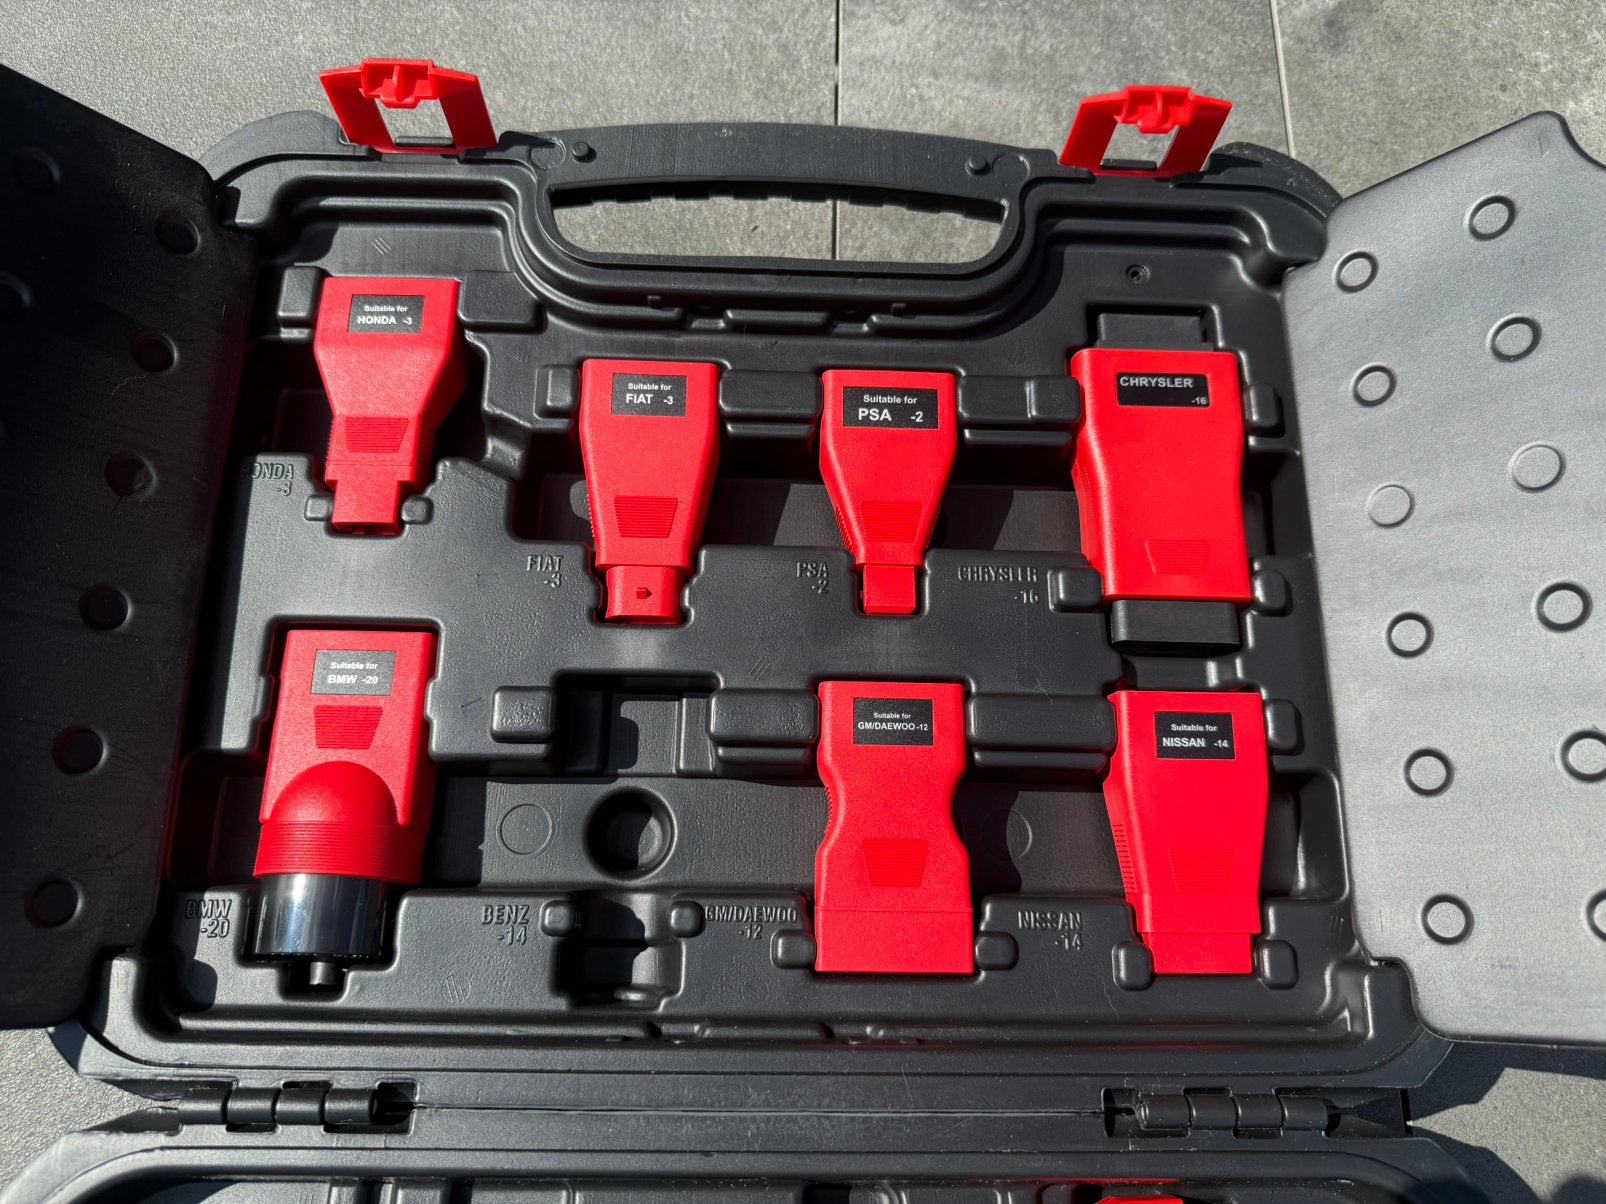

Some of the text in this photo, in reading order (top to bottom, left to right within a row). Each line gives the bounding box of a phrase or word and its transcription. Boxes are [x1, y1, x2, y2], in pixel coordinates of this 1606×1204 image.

[364, 304, 396, 312] Suitable
[357, 315, 413, 325] HONDA -3
[628, 382, 659, 390] Suitable
[1120, 376, 1193, 388] CHRYSLER
[626, 392, 674, 405] FIAT -3
[863, 394, 918, 404] Suitable for
[1191, 396, 1207, 405] -16
[858, 408, 924, 422] PSA -2
[274, 480, 293, 497] -3
[526, 554, 564, 572] FIAT
[796, 560, 829, 578] PSA
[543, 572, 562, 589] -3
[958, 565, 1038, 582] CHRYSLER
[811, 578, 829, 594] -2
[1014, 588, 1039, 604] -16
[330, 662, 378, 670] Suitable for
[328, 674, 378, 684] BMW -20
[858, 722, 915, 730] GM/DAEWOO
[1171, 724, 1218, 732] Suitable for
[1162, 737, 1230, 748] NISSAN -14
[185, 898, 233, 919] BMW
[482, 904, 530, 926] BENZ
[704, 904, 797, 924] GM/DAEWOO
[200, 918, 231, 938] -20
[1018, 910, 1082, 931] NISSAN
[497, 925, 528, 946] -14
[739, 924, 763, 940] -12
[1054, 931, 1082, 952] -14
